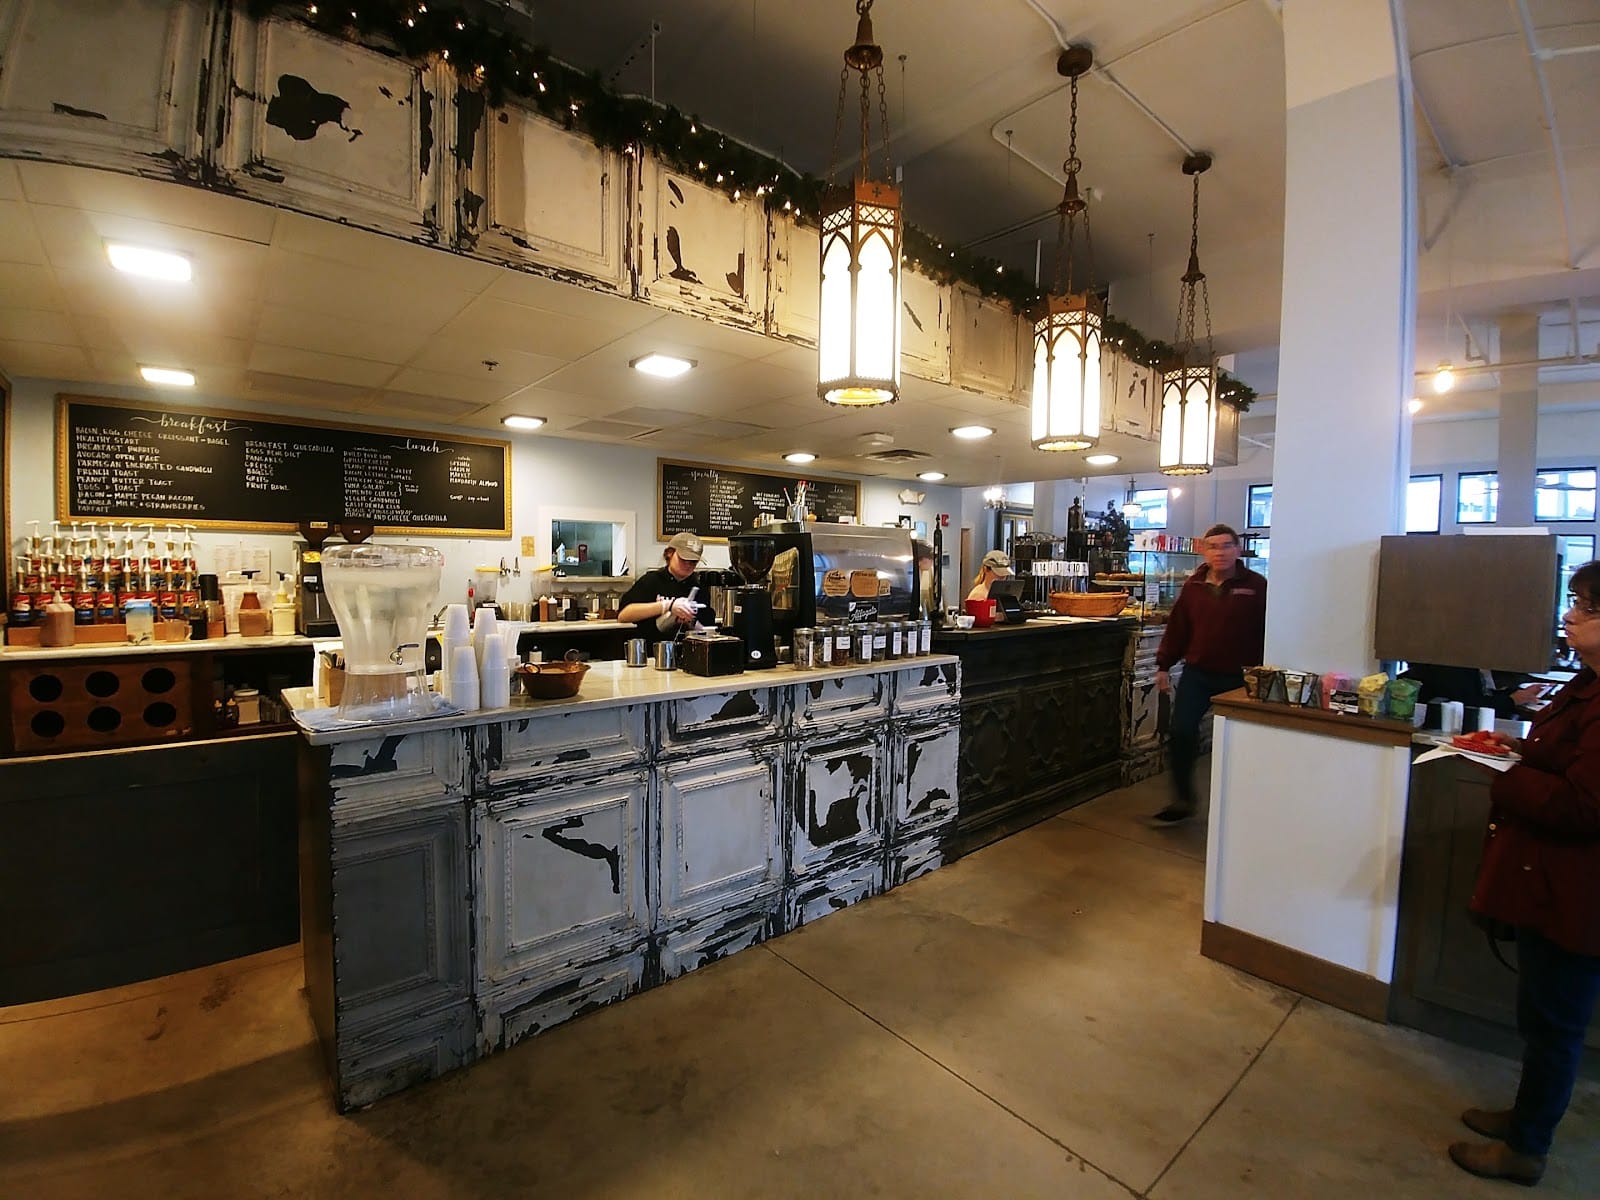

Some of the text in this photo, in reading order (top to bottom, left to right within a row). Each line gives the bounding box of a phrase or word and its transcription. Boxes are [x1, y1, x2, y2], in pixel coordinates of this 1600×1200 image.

[149, 413, 239, 434] breakfast
[76, 434, 110, 443] HEALTHY
[76, 442, 122, 451] BREAKFAST
[400, 438, 446, 453] lunch
[76, 451, 110, 459] AVOCADO
[77, 468, 109, 476] FRENCH
[176, 465, 213, 474] SANDWICH
[114, 484, 140, 492] TOAST
[246, 482, 268, 490] FRUIT
